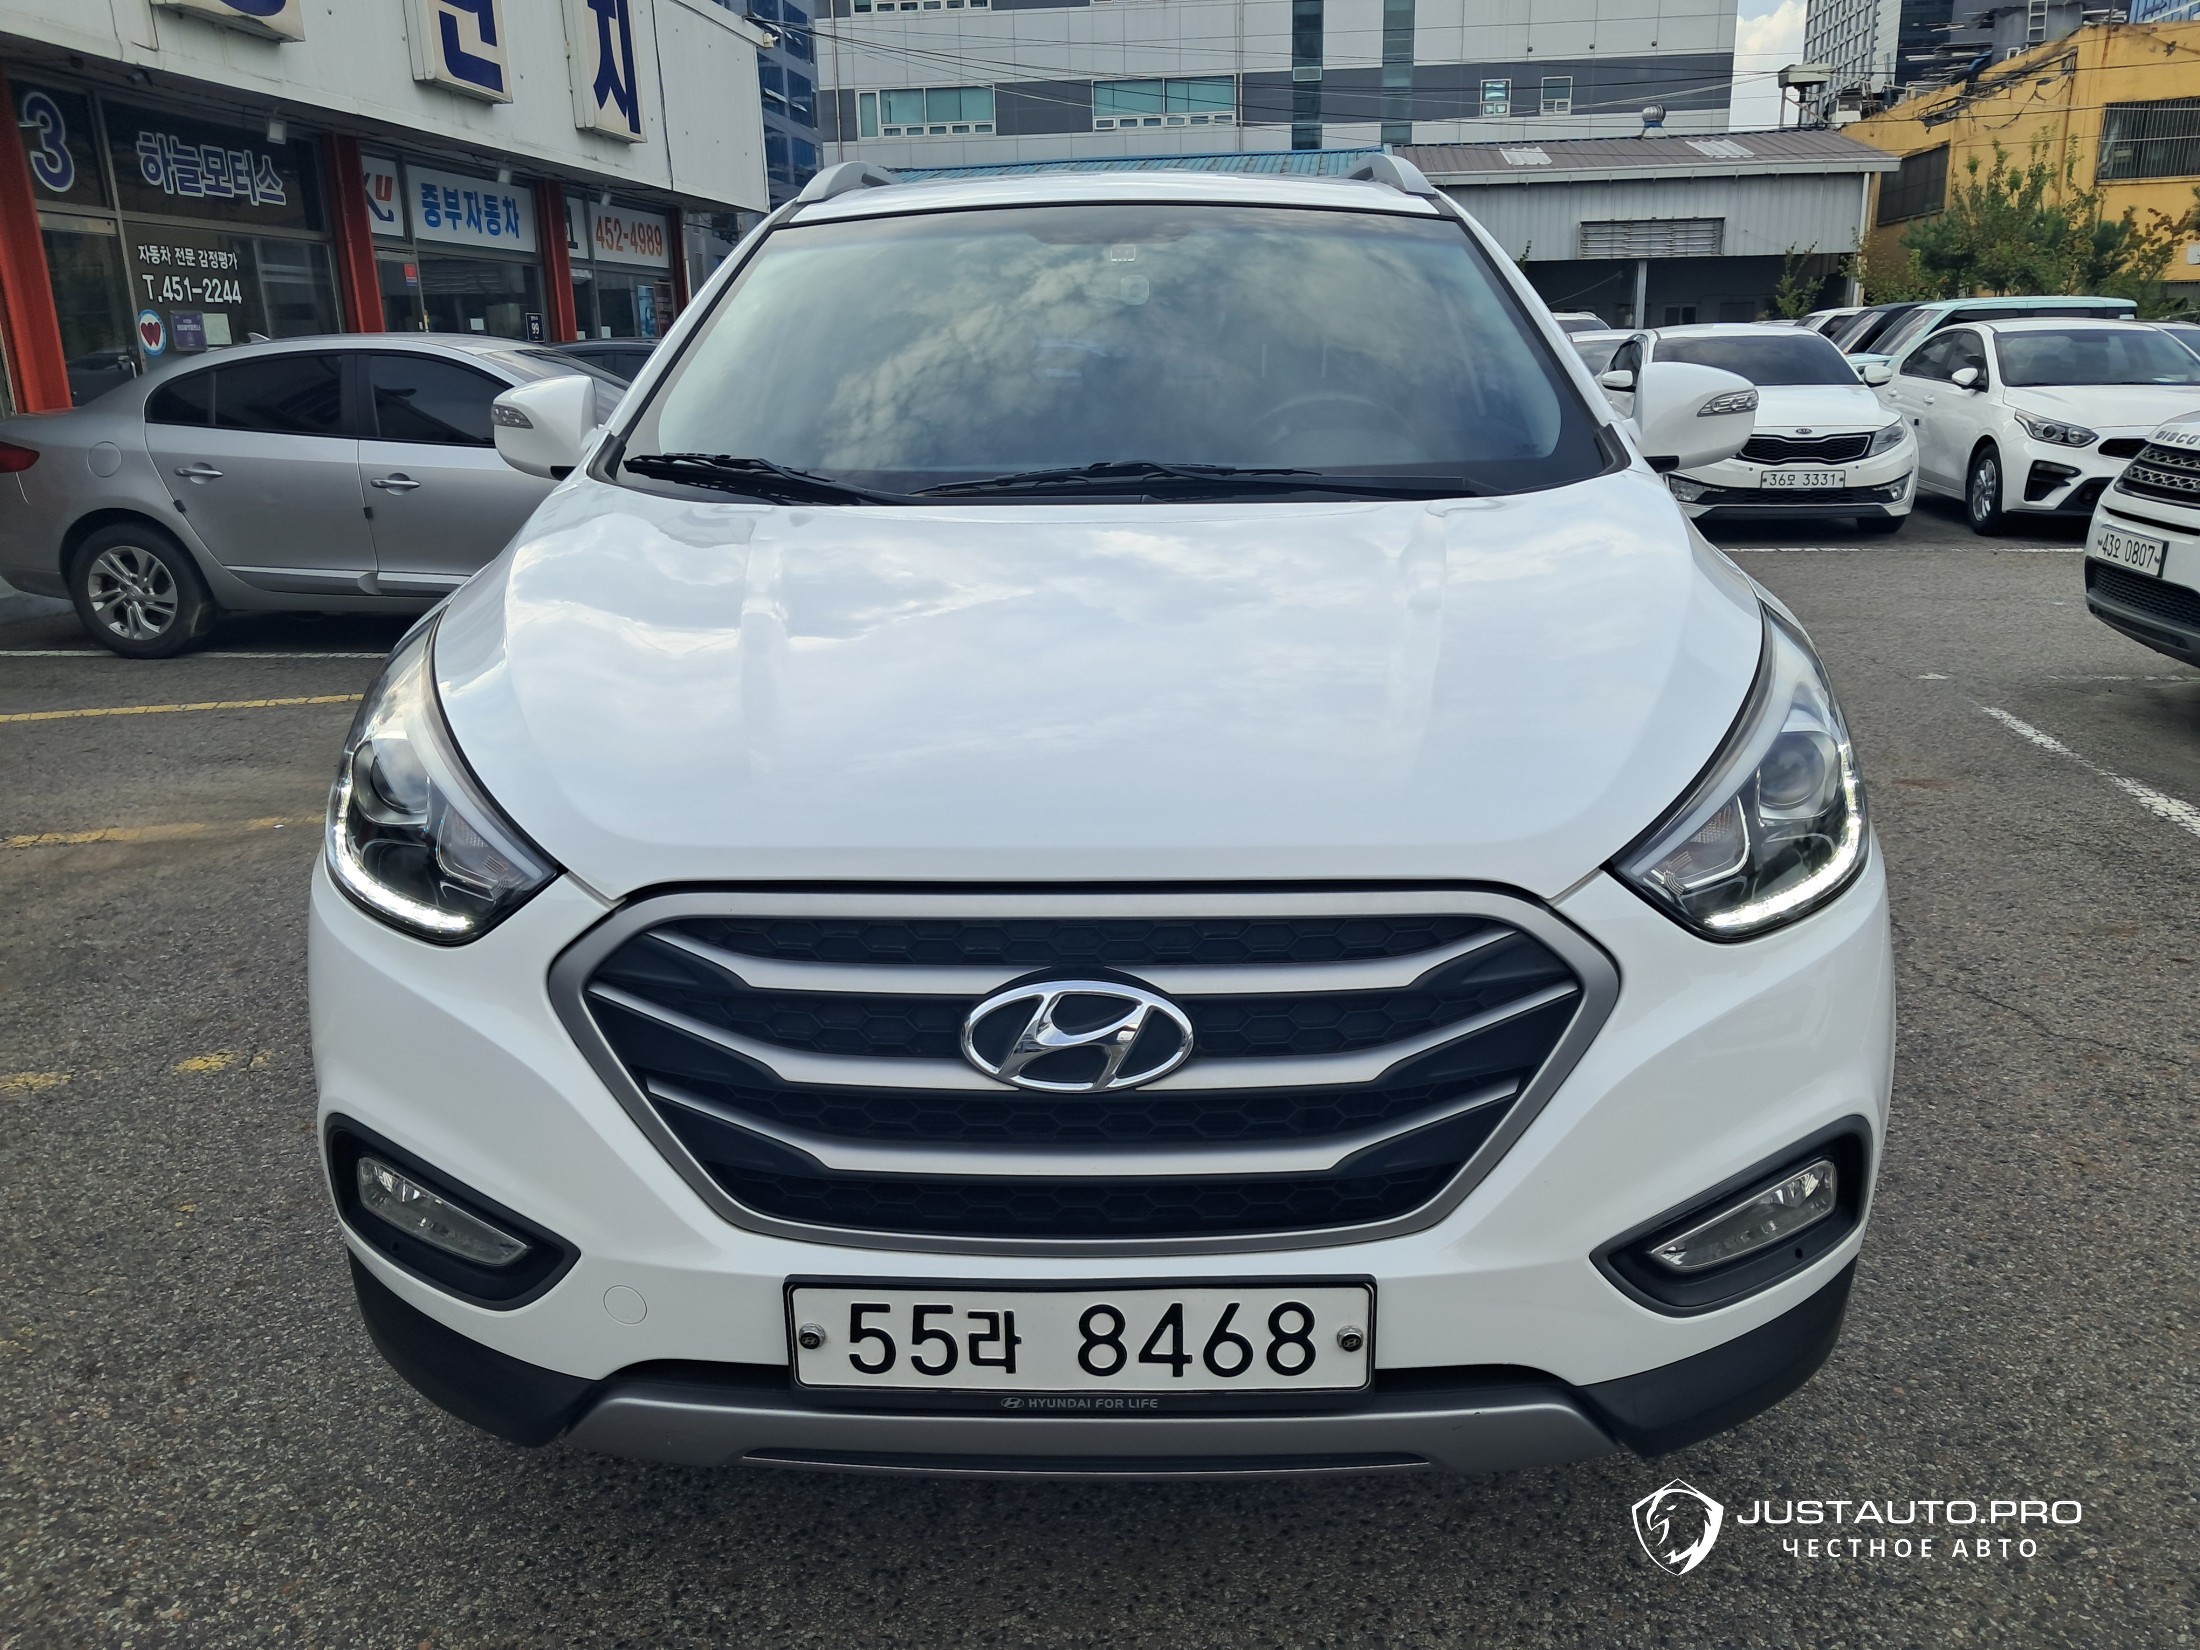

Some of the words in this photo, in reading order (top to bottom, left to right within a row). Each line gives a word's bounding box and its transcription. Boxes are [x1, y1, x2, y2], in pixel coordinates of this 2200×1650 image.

[23, 91, 75, 192] 3
[136, 131, 286, 206] 하늘모터스
[420, 182, 519, 239] 중부자동차
[595, 215, 663, 257] 452-4989
[138, 244, 171, 265] 자동차
[174, 247, 196, 266] 전문
[198, 249, 238, 270] 감정평가
[2155, 430, 2200, 445] DISCO
[1769, 473, 1796, 486] 36모
[1802, 473, 1836, 486] 3331
[2102, 533, 2121, 559] 43오
[2124, 539, 2155, 568] 0807
[848, 1302, 1022, 1376] 55라
[1076, 1301, 1317, 1378] 8468
[1028, 1398, 1091, 1409] HYUNDAI
[1095, 1398, 1124, 1409] FOR
[1128, 1398, 1158, 1409] LIFE
